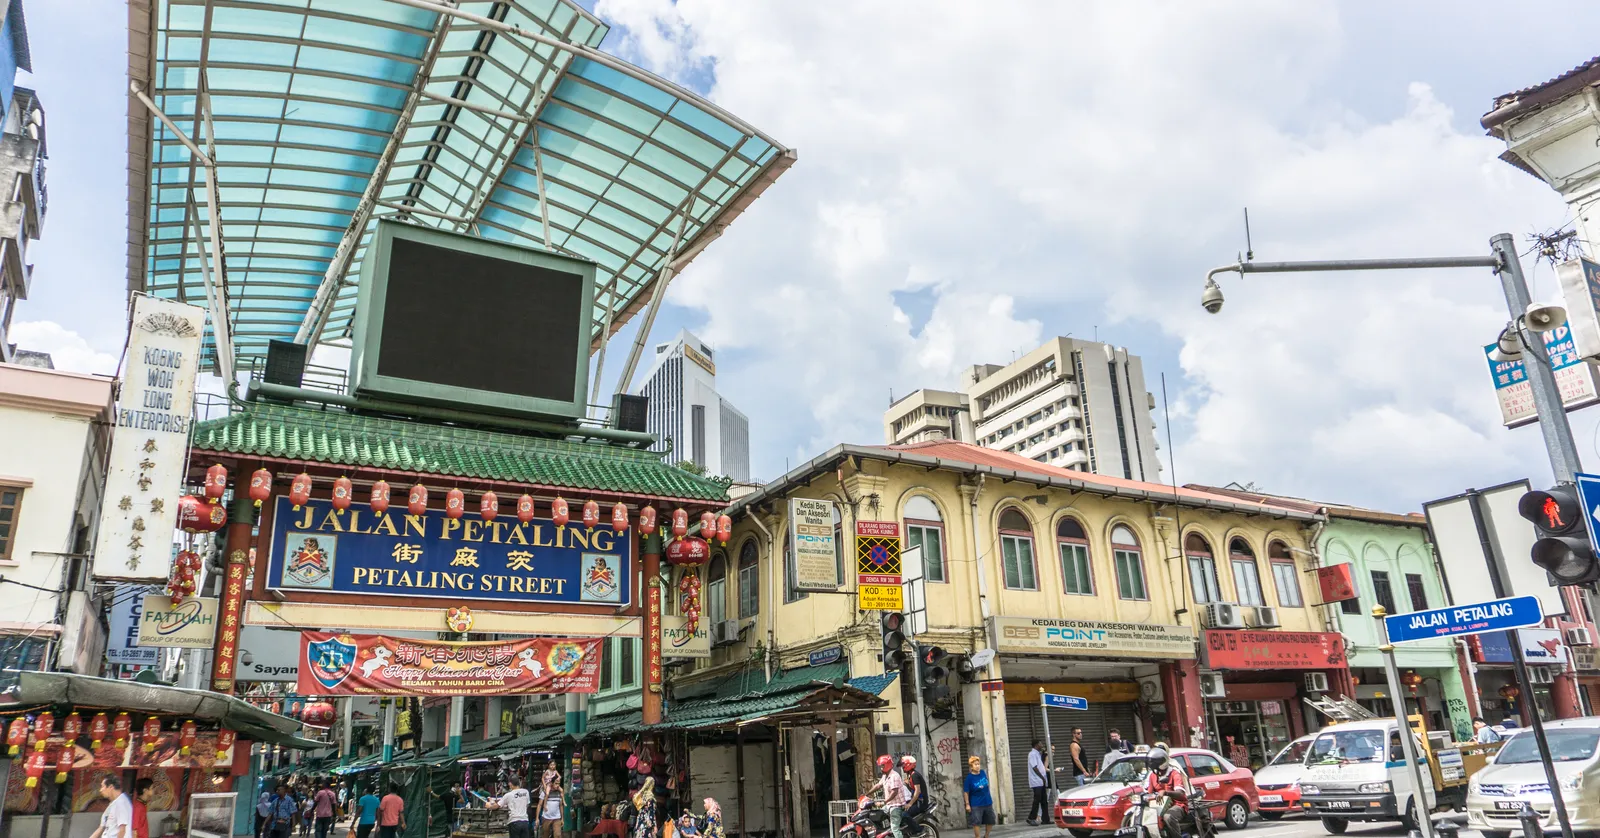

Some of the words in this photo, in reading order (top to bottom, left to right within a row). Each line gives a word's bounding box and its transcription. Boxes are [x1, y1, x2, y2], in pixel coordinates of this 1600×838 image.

[148, 368, 174, 389] WOH
[144, 390, 172, 410] TONG
[118, 408, 188, 434] ENTERPRISE
[800, 501, 814, 510] Kedai
[816, 502, 826, 511] Beg
[808, 510, 830, 518] Aksesori
[294, 506, 428, 538] JALAN
[439, 518, 616, 551] PETALING
[352, 567, 474, 590] PETALING
[480, 574, 566, 594] STREET
[145, 611, 212, 625] FATTUAH
[1409, 612, 1447, 629] JALAN
[1454, 602, 1513, 623] PETALING
[663, 628, 707, 639] FATTAH
[108, 649, 117, 657] TEL
[383, 664, 426, 680] Happy
[426, 664, 471, 678] Chinese
[470, 666, 494, 678] New
[492, 666, 523, 680] Year
